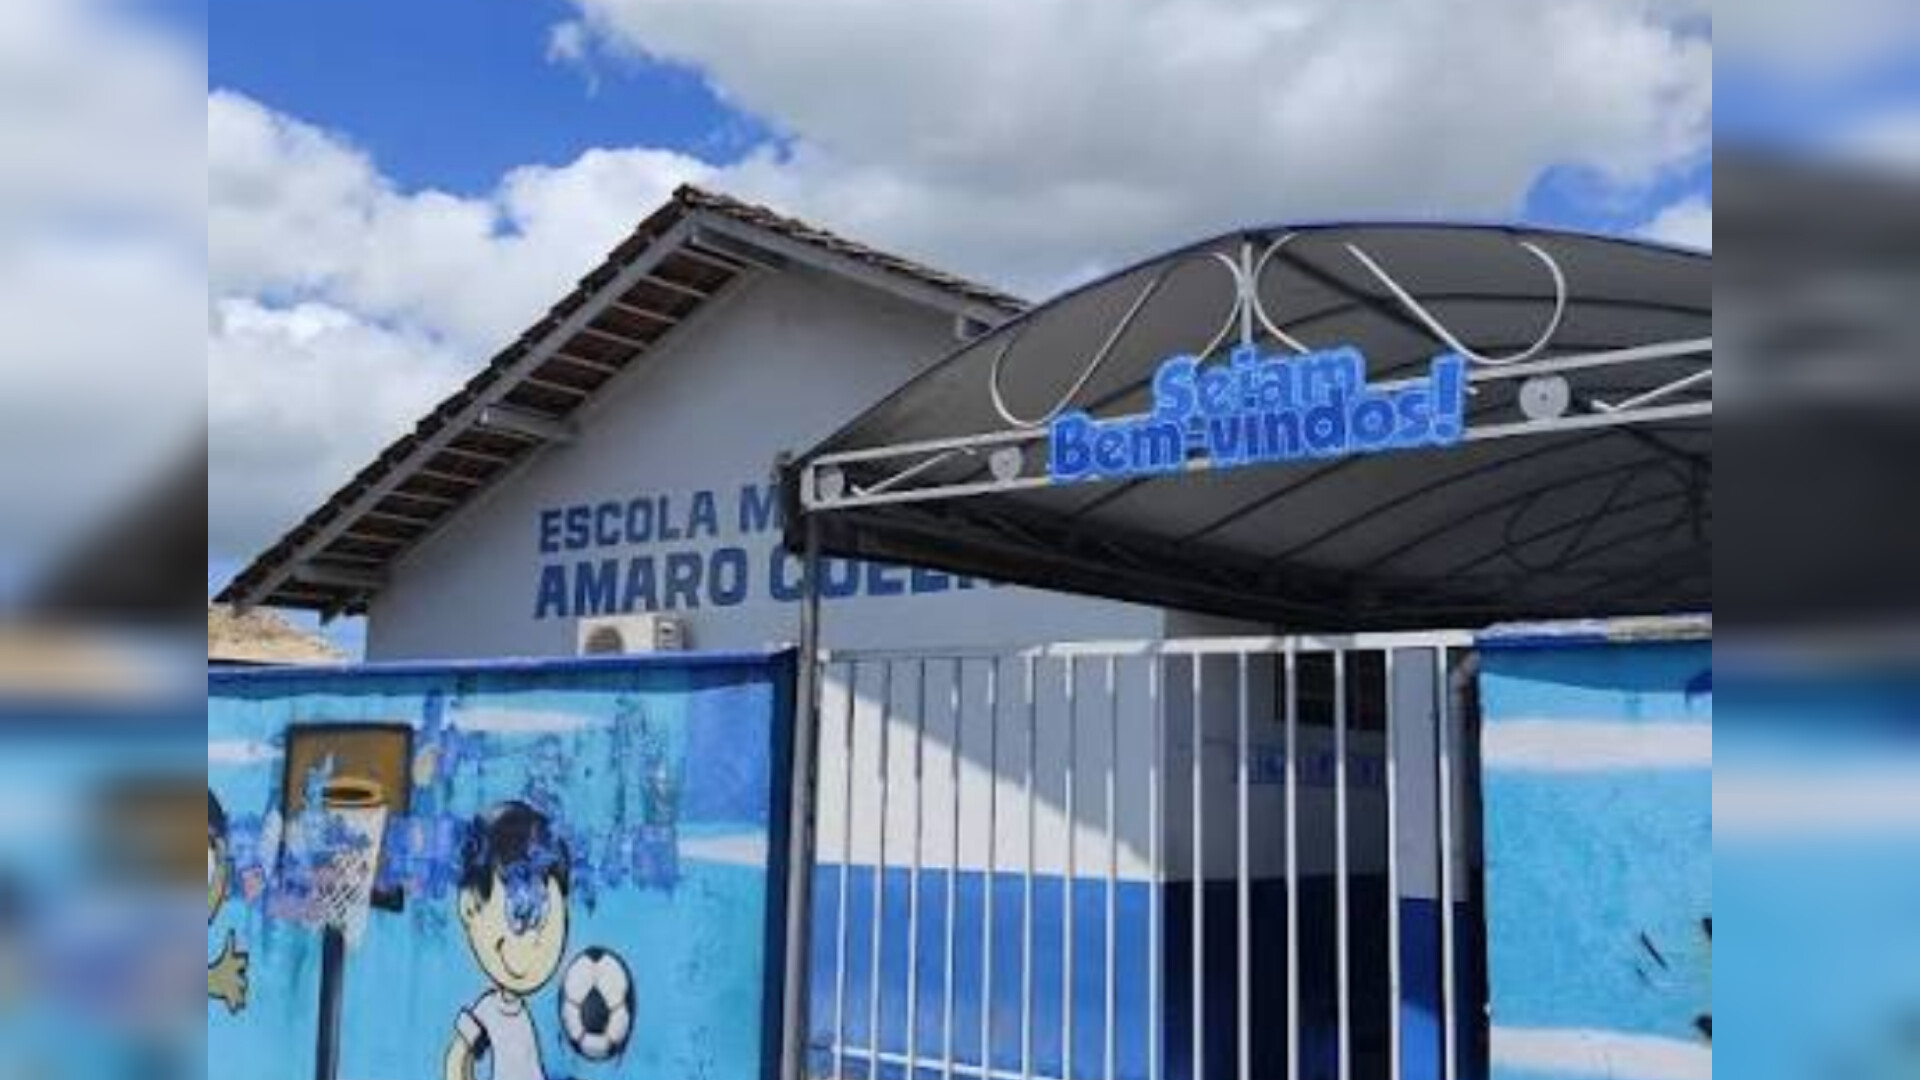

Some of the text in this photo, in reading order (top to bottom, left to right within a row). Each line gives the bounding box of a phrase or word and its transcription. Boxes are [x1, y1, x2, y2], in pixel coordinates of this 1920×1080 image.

[1051, 357, 1464, 478] Bem-vindos!
[539, 484, 718, 554] ESCOLA
[534, 547, 748, 620] AMARO
